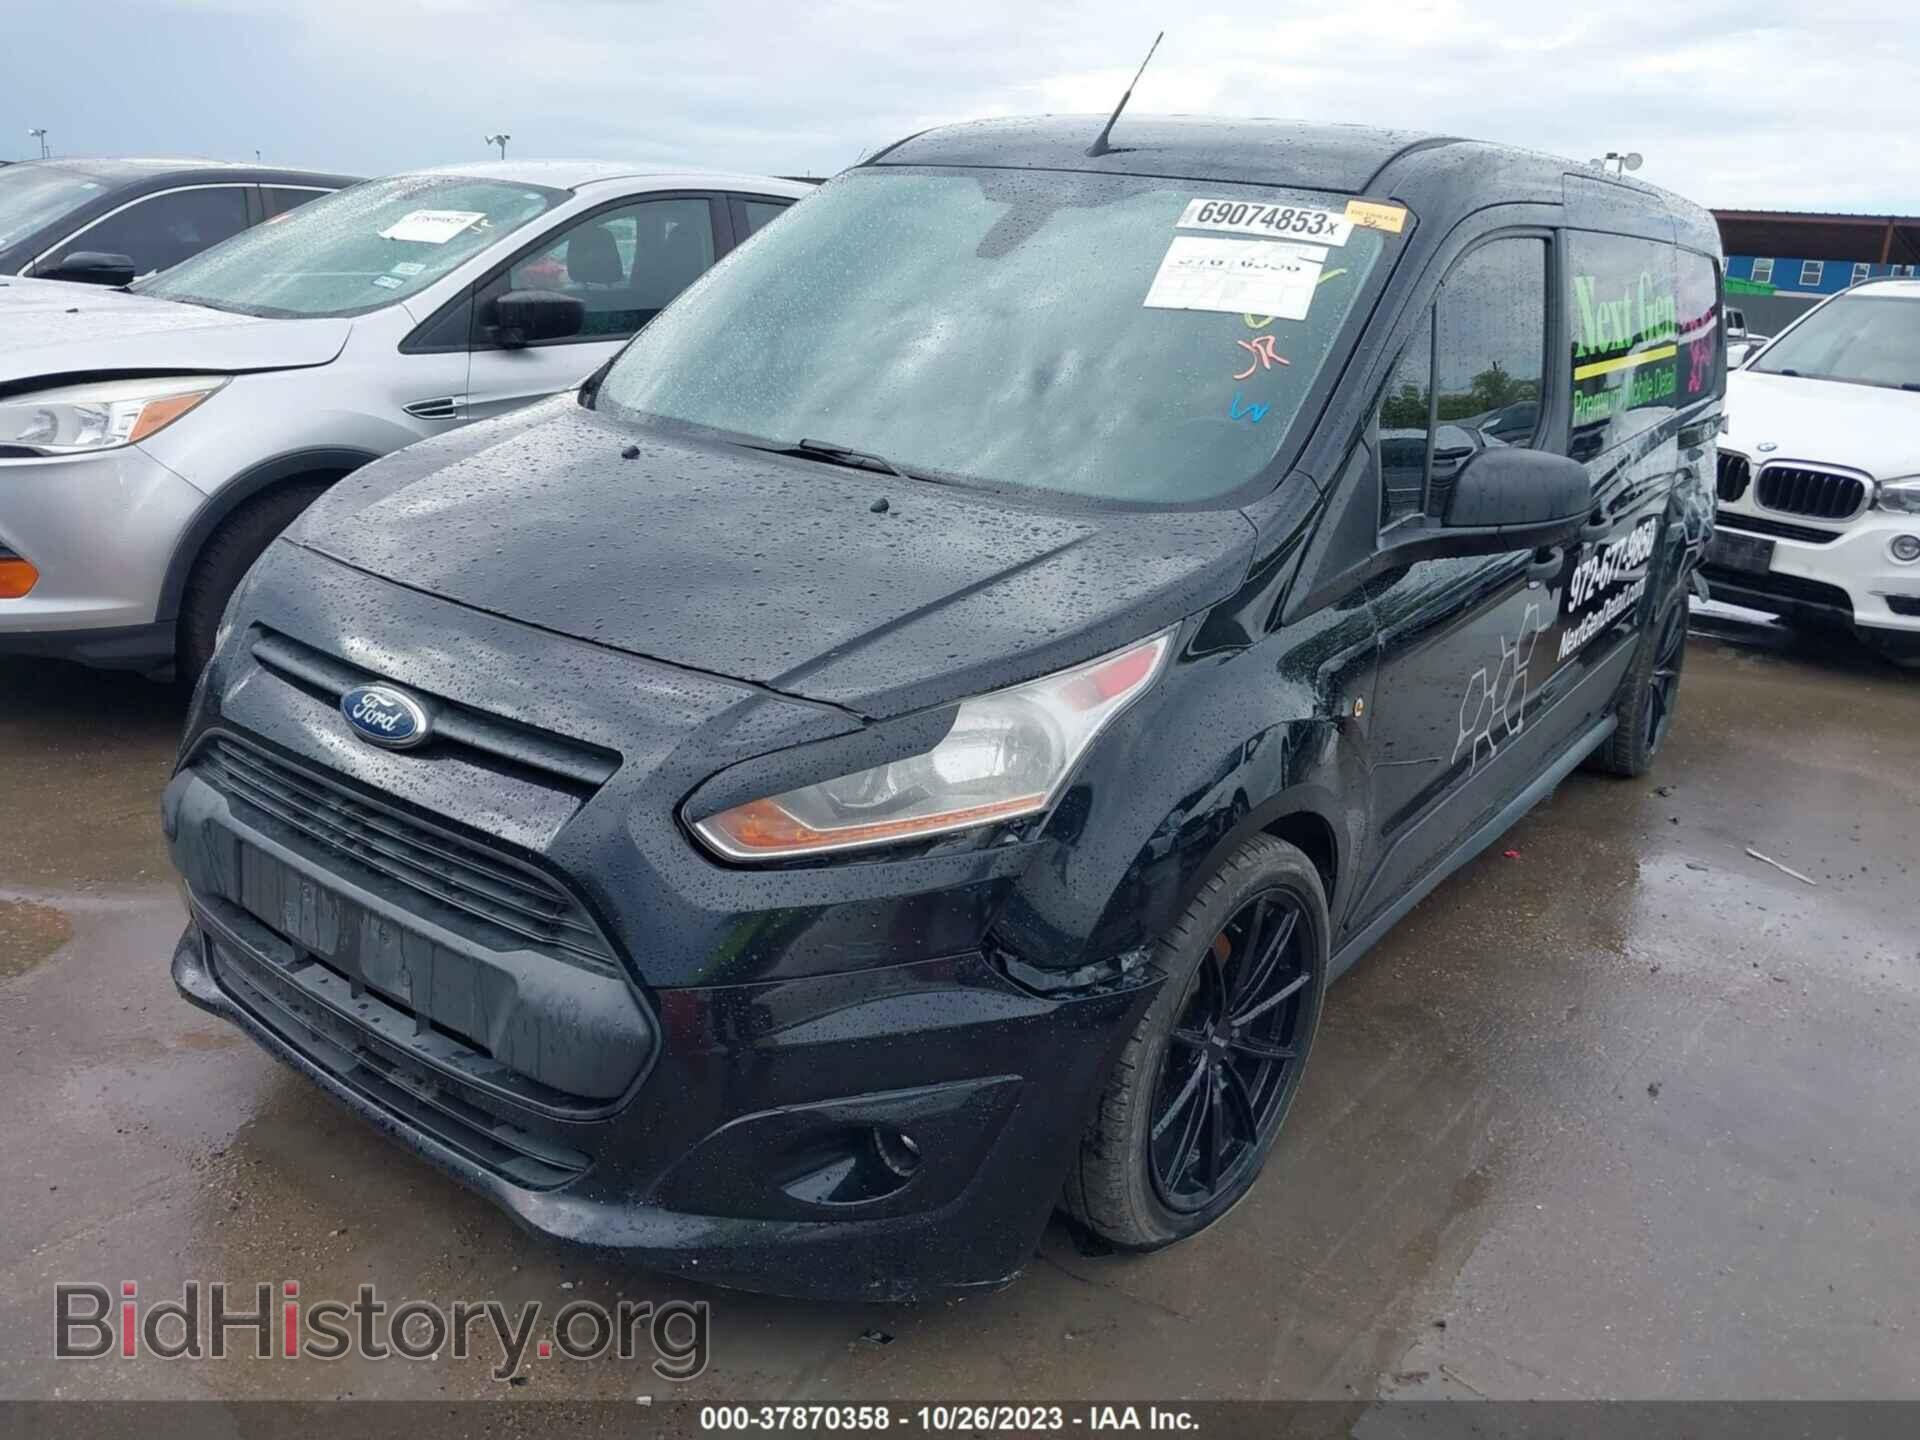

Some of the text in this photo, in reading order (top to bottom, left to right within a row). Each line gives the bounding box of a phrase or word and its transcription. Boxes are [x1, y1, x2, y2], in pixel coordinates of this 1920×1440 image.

[1573, 271, 1677, 358] Next Gen
[353, 693, 402, 731] Ford
